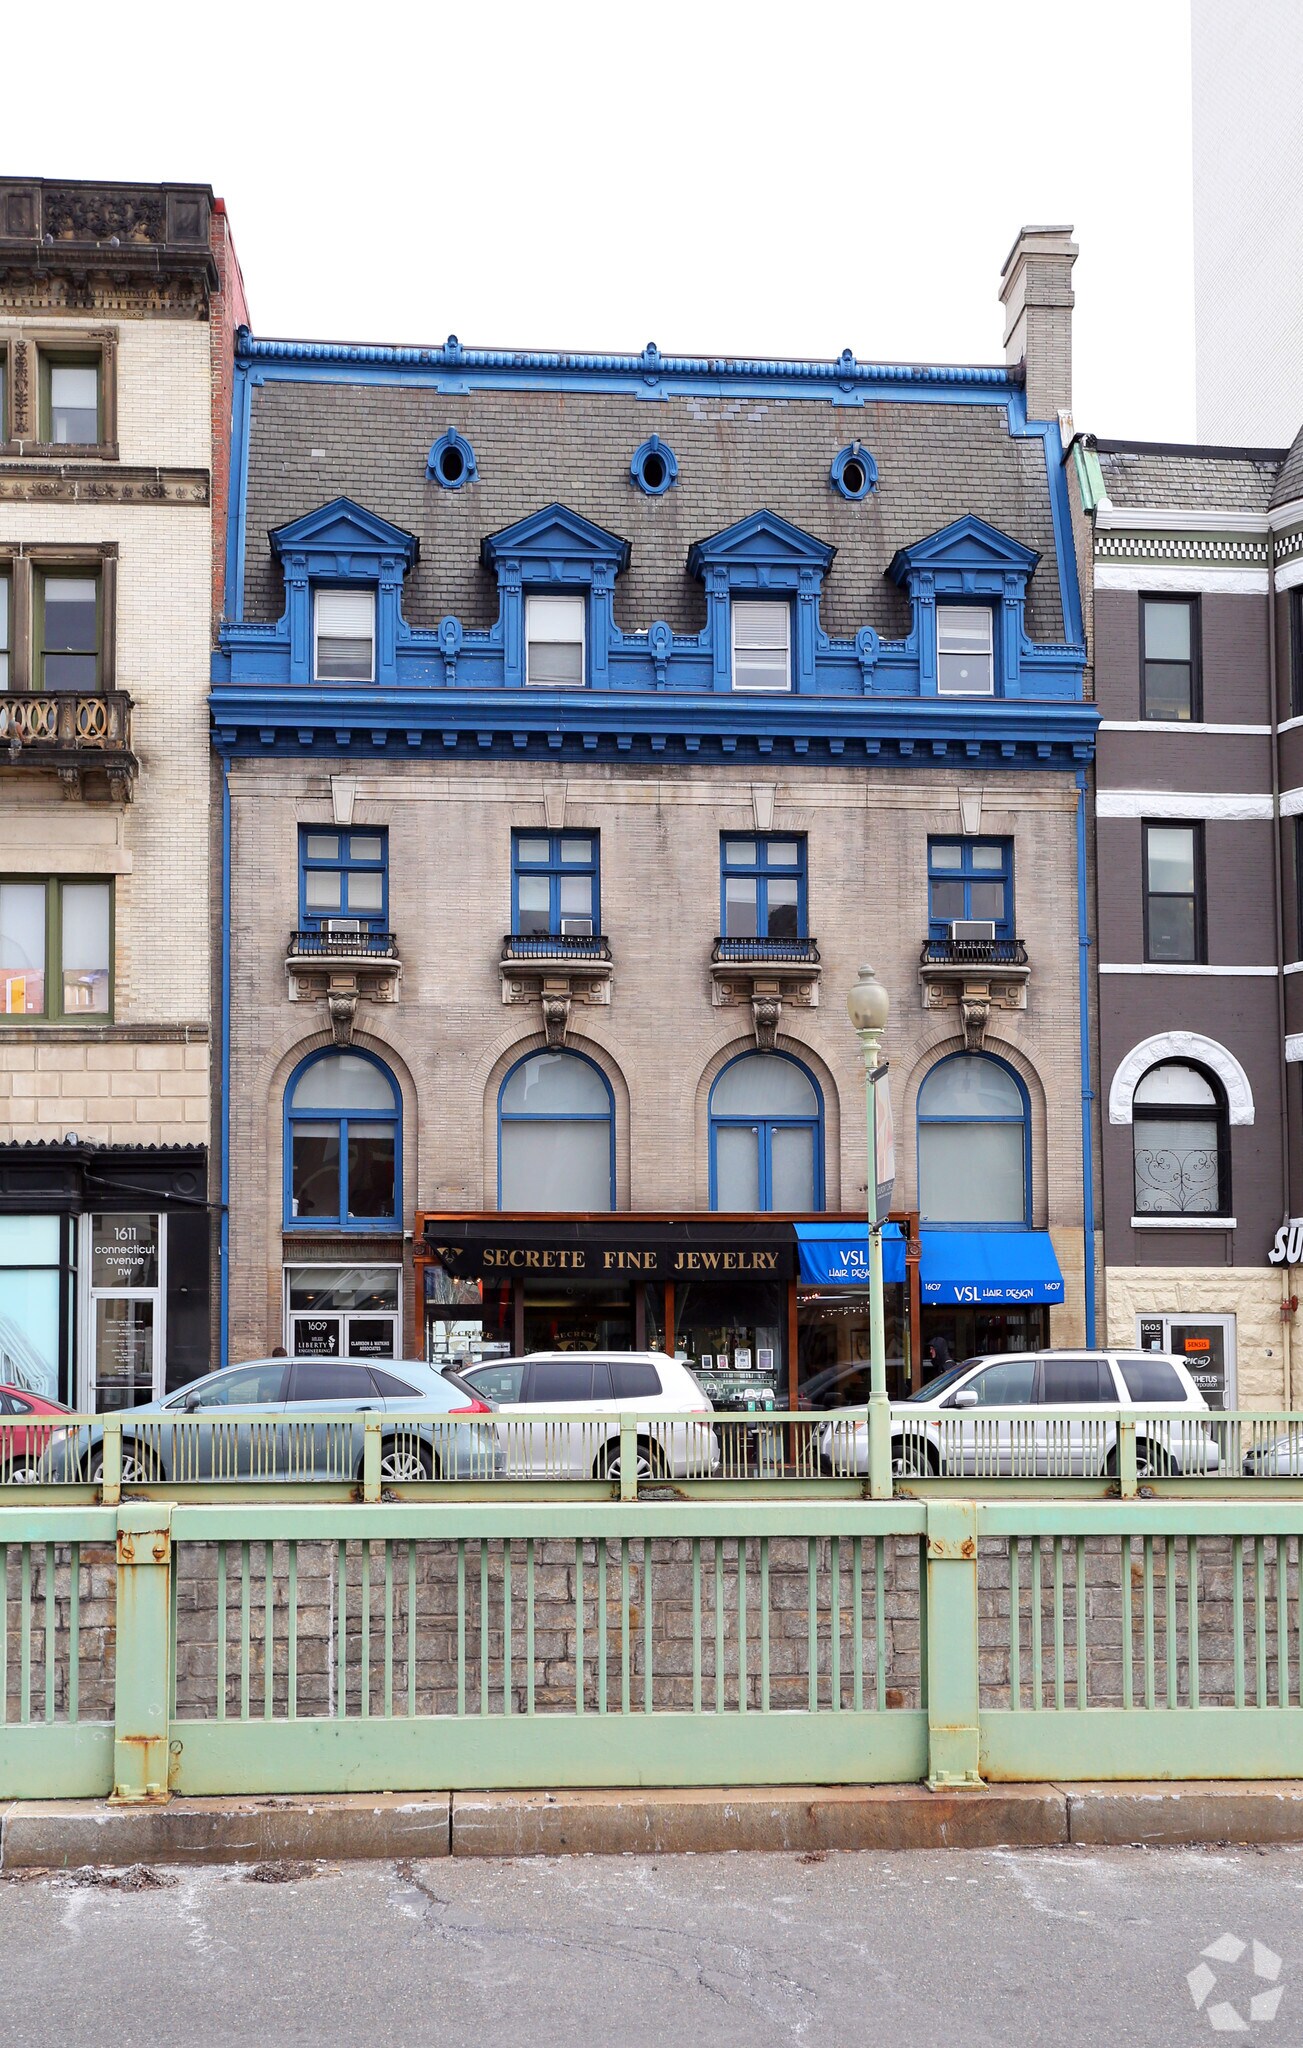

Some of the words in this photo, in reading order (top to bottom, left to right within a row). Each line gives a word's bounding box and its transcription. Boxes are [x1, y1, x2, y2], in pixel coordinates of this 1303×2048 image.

[114, 1227, 137, 1240] 1611
[95, 1244, 155, 1254] connecticut
[1268, 1226, 1303, 1264] SU
[106, 1257, 145, 1265] avenue
[482, 1248, 586, 1269] SECRETE
[603, 1251, 658, 1269] FINE
[674, 1251, 780, 1270] JEWELRY
[839, 1250, 868, 1266] VSL
[117, 1268, 132, 1276] nw
[828, 1268, 849, 1277] HAIR
[851, 1268, 870, 1279] DESI
[925, 1283, 942, 1291] 1607
[1044, 1282, 1061, 1290] 1607
[953, 1286, 982, 1301] VSL
[982, 1288, 1003, 1297] HAIR
[1005, 1288, 1034, 1300] DESIGN
[307, 1321, 328, 1331] 1609
[1141, 1323, 1161, 1331] 1605
